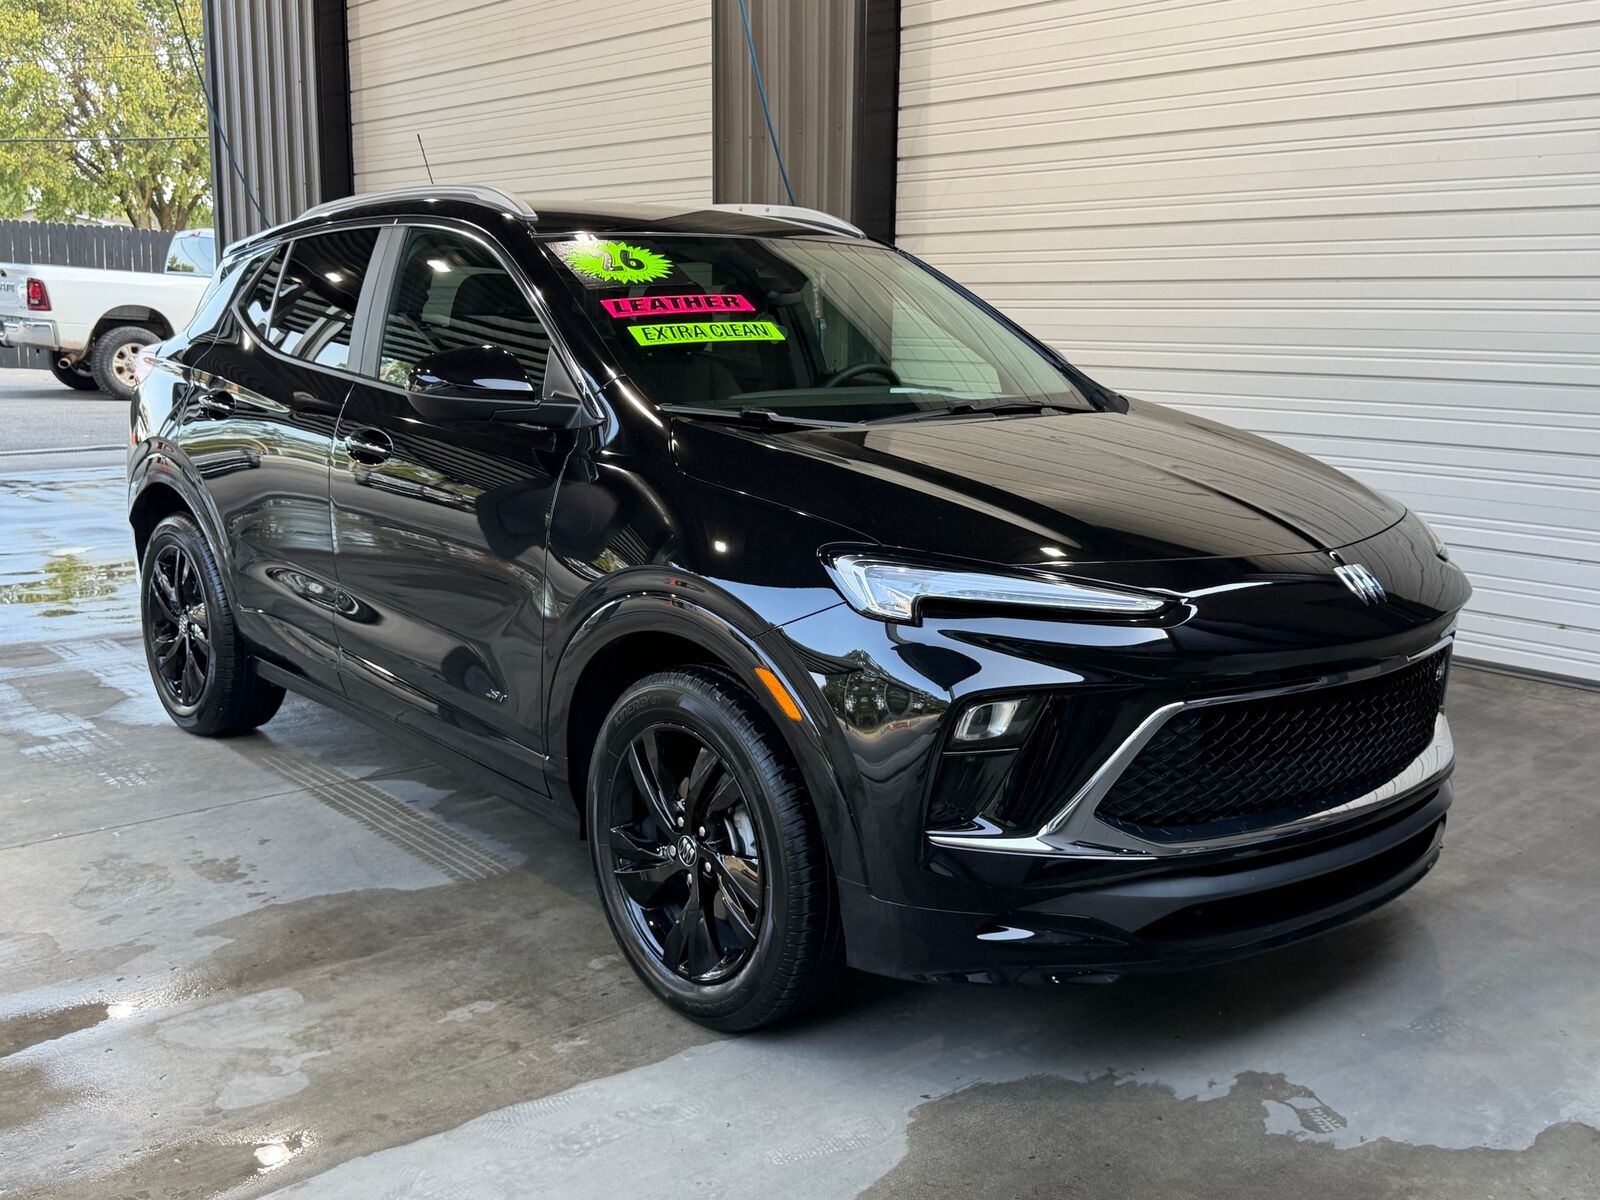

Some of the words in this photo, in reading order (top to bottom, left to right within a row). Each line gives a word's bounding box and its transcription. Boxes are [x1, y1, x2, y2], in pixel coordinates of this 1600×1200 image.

[601, 250, 646, 272] 26
[612, 296, 741, 313] LEATHER
[641, 324, 706, 341] EXTRA
[709, 323, 769, 338] CLEAN
